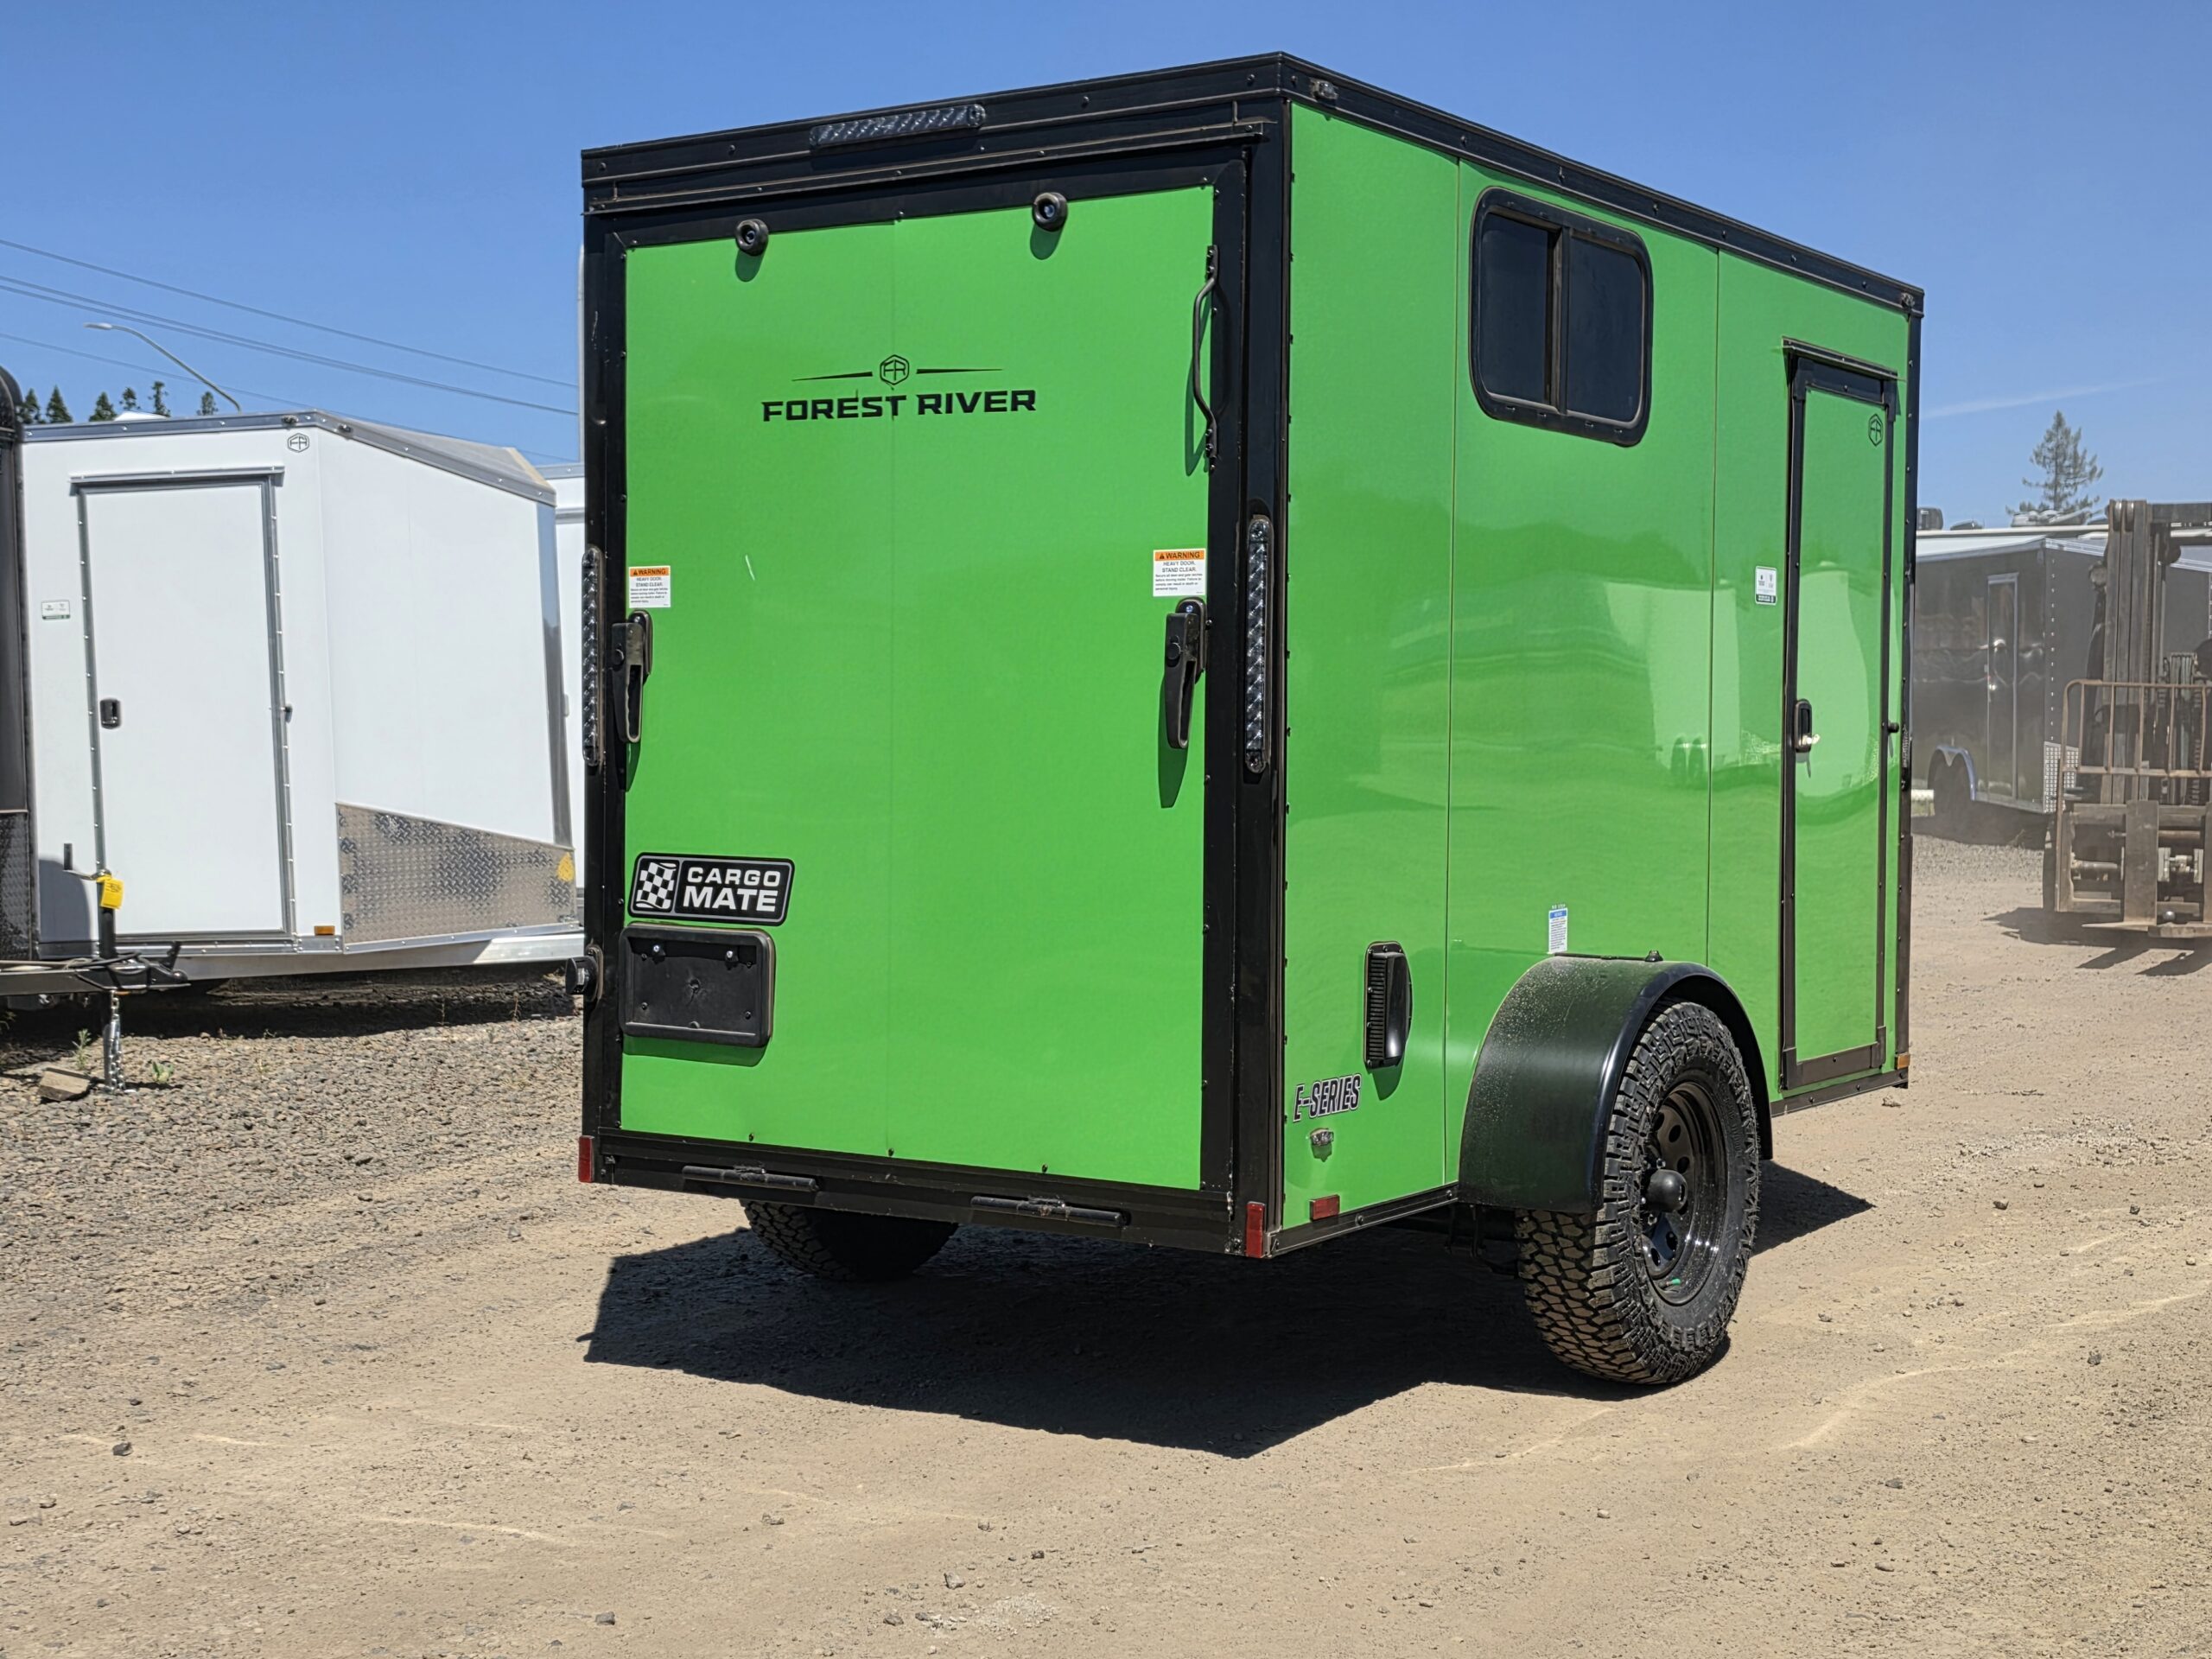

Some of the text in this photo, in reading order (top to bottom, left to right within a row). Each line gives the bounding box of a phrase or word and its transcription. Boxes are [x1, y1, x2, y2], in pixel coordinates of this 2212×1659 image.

[761, 390, 1037, 422] FOREST RIVER
[683, 867, 781, 912] CARGO MATE
[1293, 1073, 1362, 1123] E-SERIES
